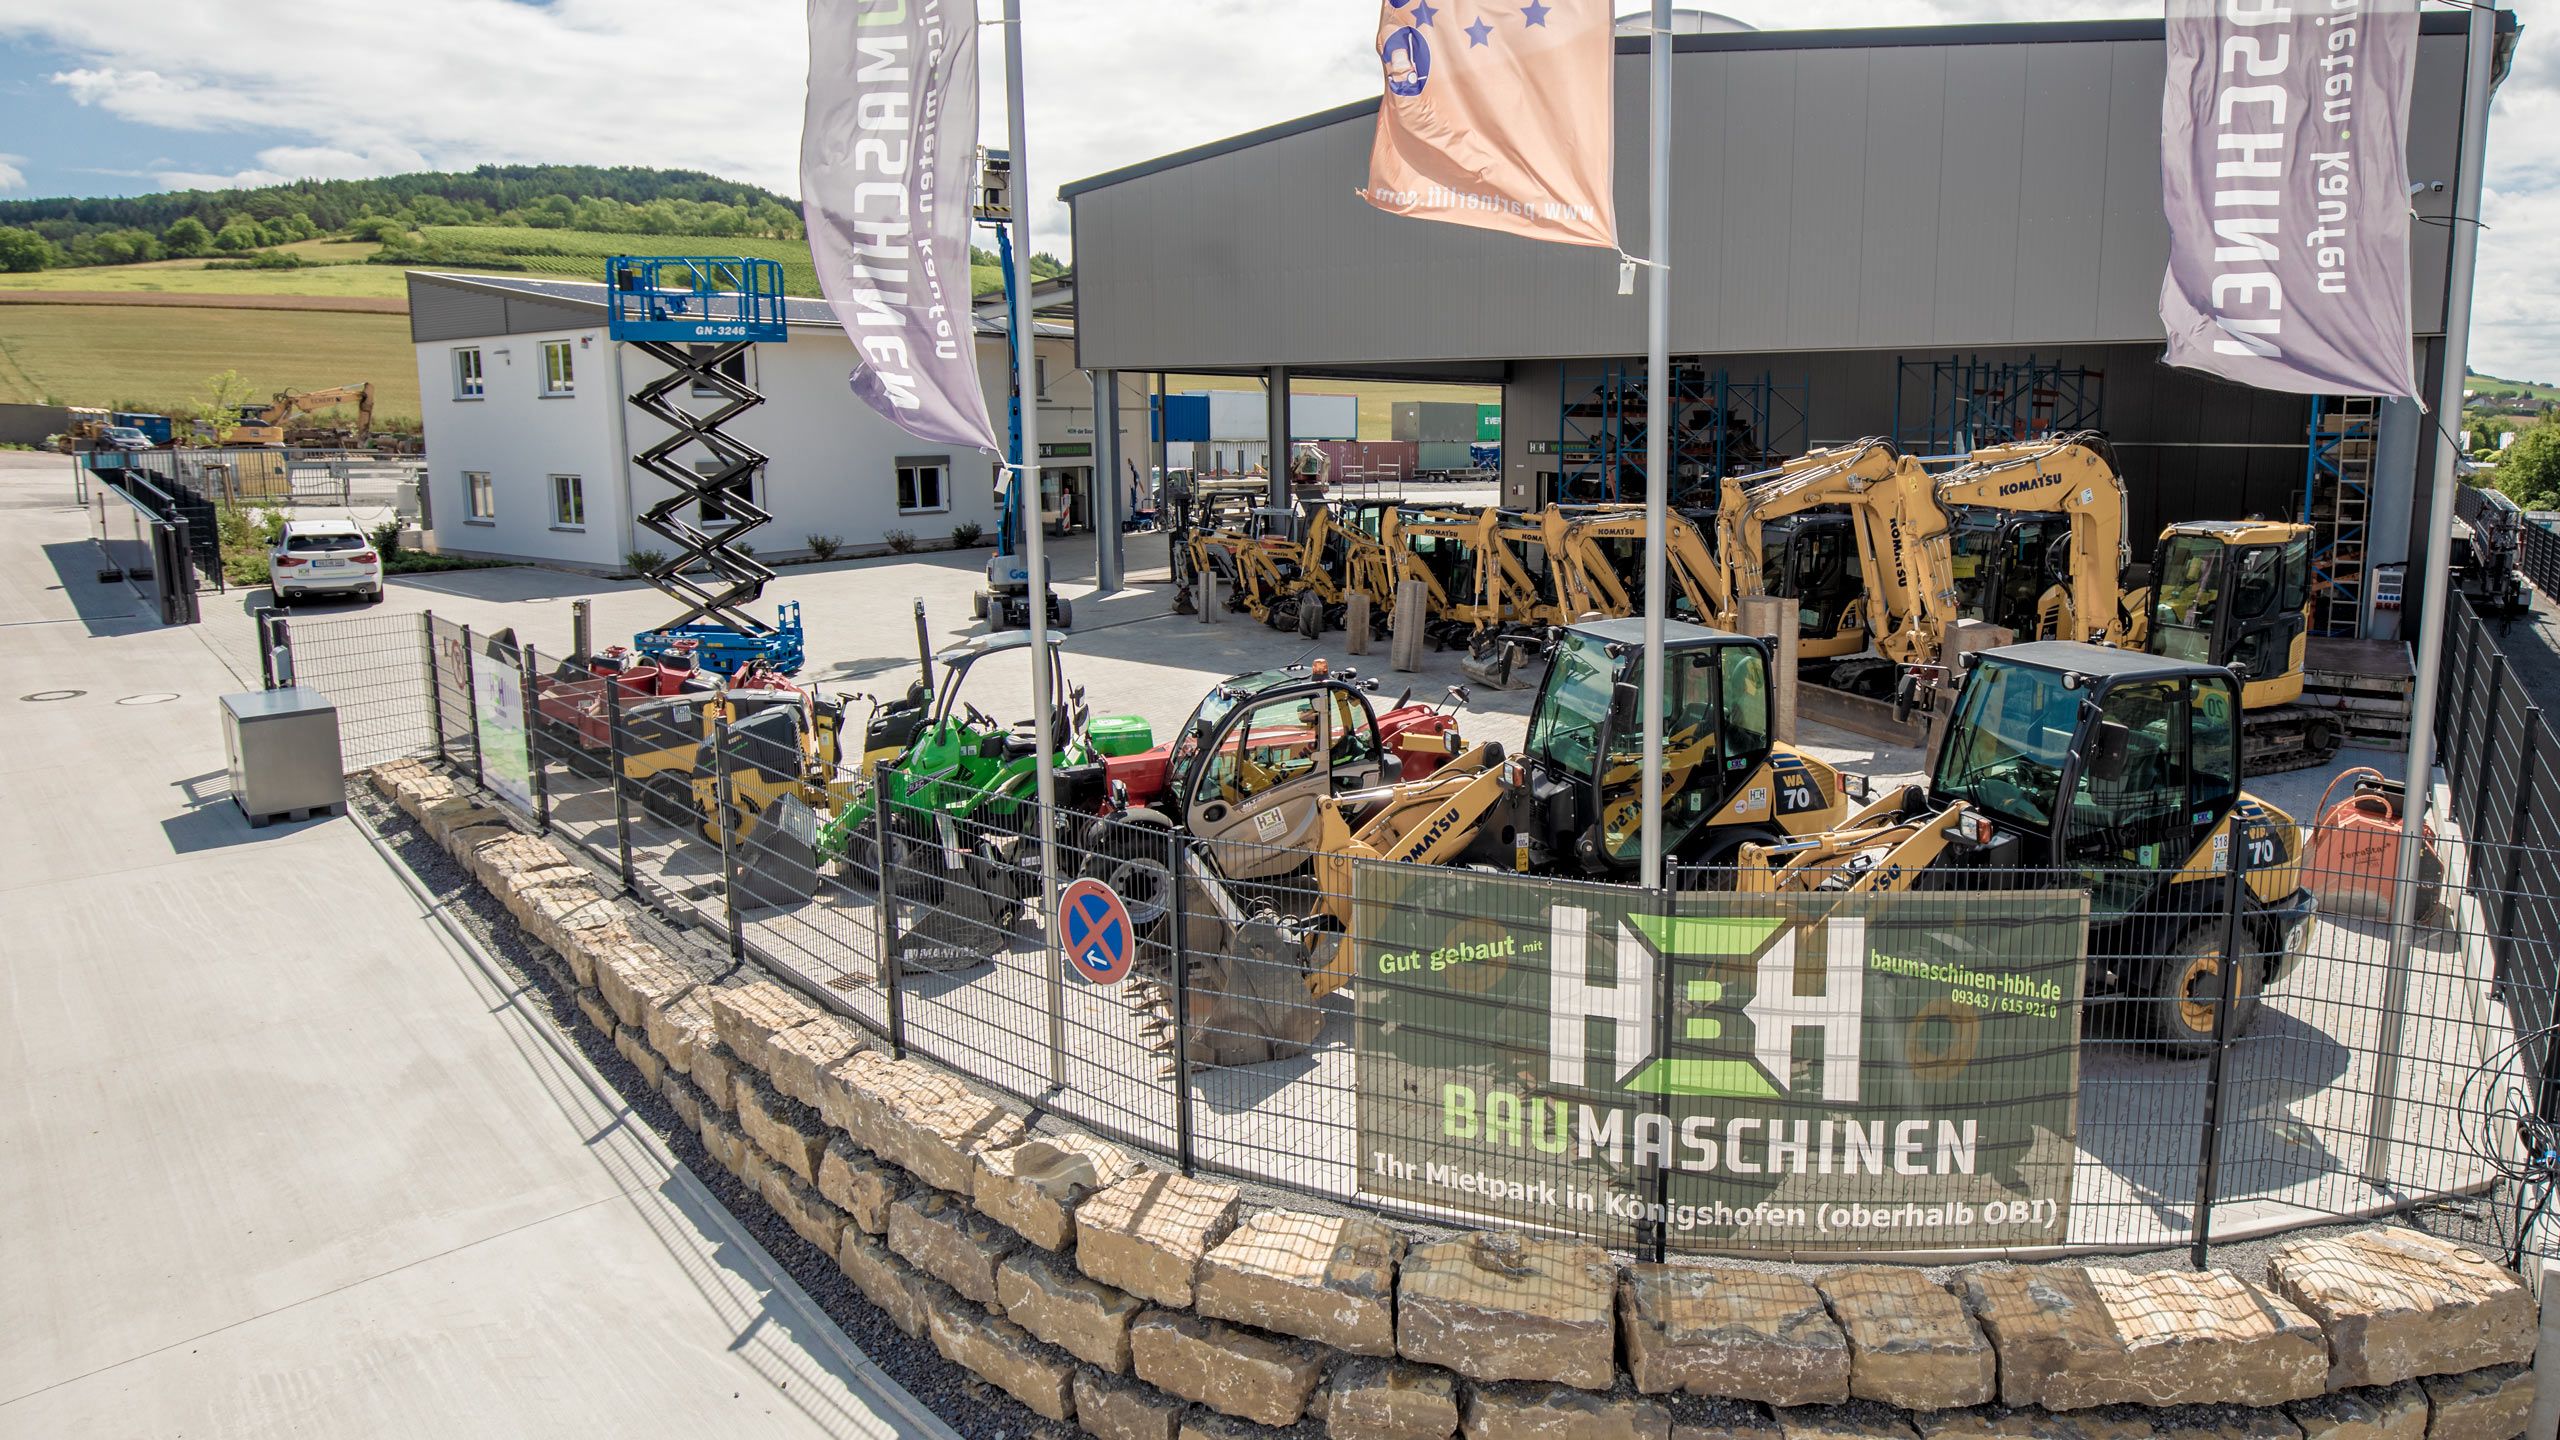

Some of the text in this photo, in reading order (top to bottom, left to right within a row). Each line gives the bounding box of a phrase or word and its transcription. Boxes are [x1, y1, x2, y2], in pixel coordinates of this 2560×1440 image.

[695, 326, 746, 336] GN-3246
[1999, 473, 2062, 497] KOMATSU
[1424, 528, 1459, 538] KOMATSU
[1521, 533, 1545, 542] KOMA
[1598, 527, 1635, 536] KOMATSU
[1782, 774, 1805, 787] WA
[1783, 787, 1810, 809] 70
[2214, 835, 2228, 848] 318
[2248, 839, 2274, 865] 70
[1378, 935, 1543, 974] Gut gebaut mit
[1871, 949, 2061, 1001] baumaschinen-hbh.de
[1952, 988, 1989, 1009] 09343
[2001, 997, 2023, 1014] 615
[2025, 1001, 2047, 1018] 921
[2049, 1004, 2057, 1019] 0
[1443, 1083, 1978, 1176] BAUMASCHINEN
[1373, 1152, 2058, 1233] Ihr Mietpark in Königshofen (oberhalb OBI)
